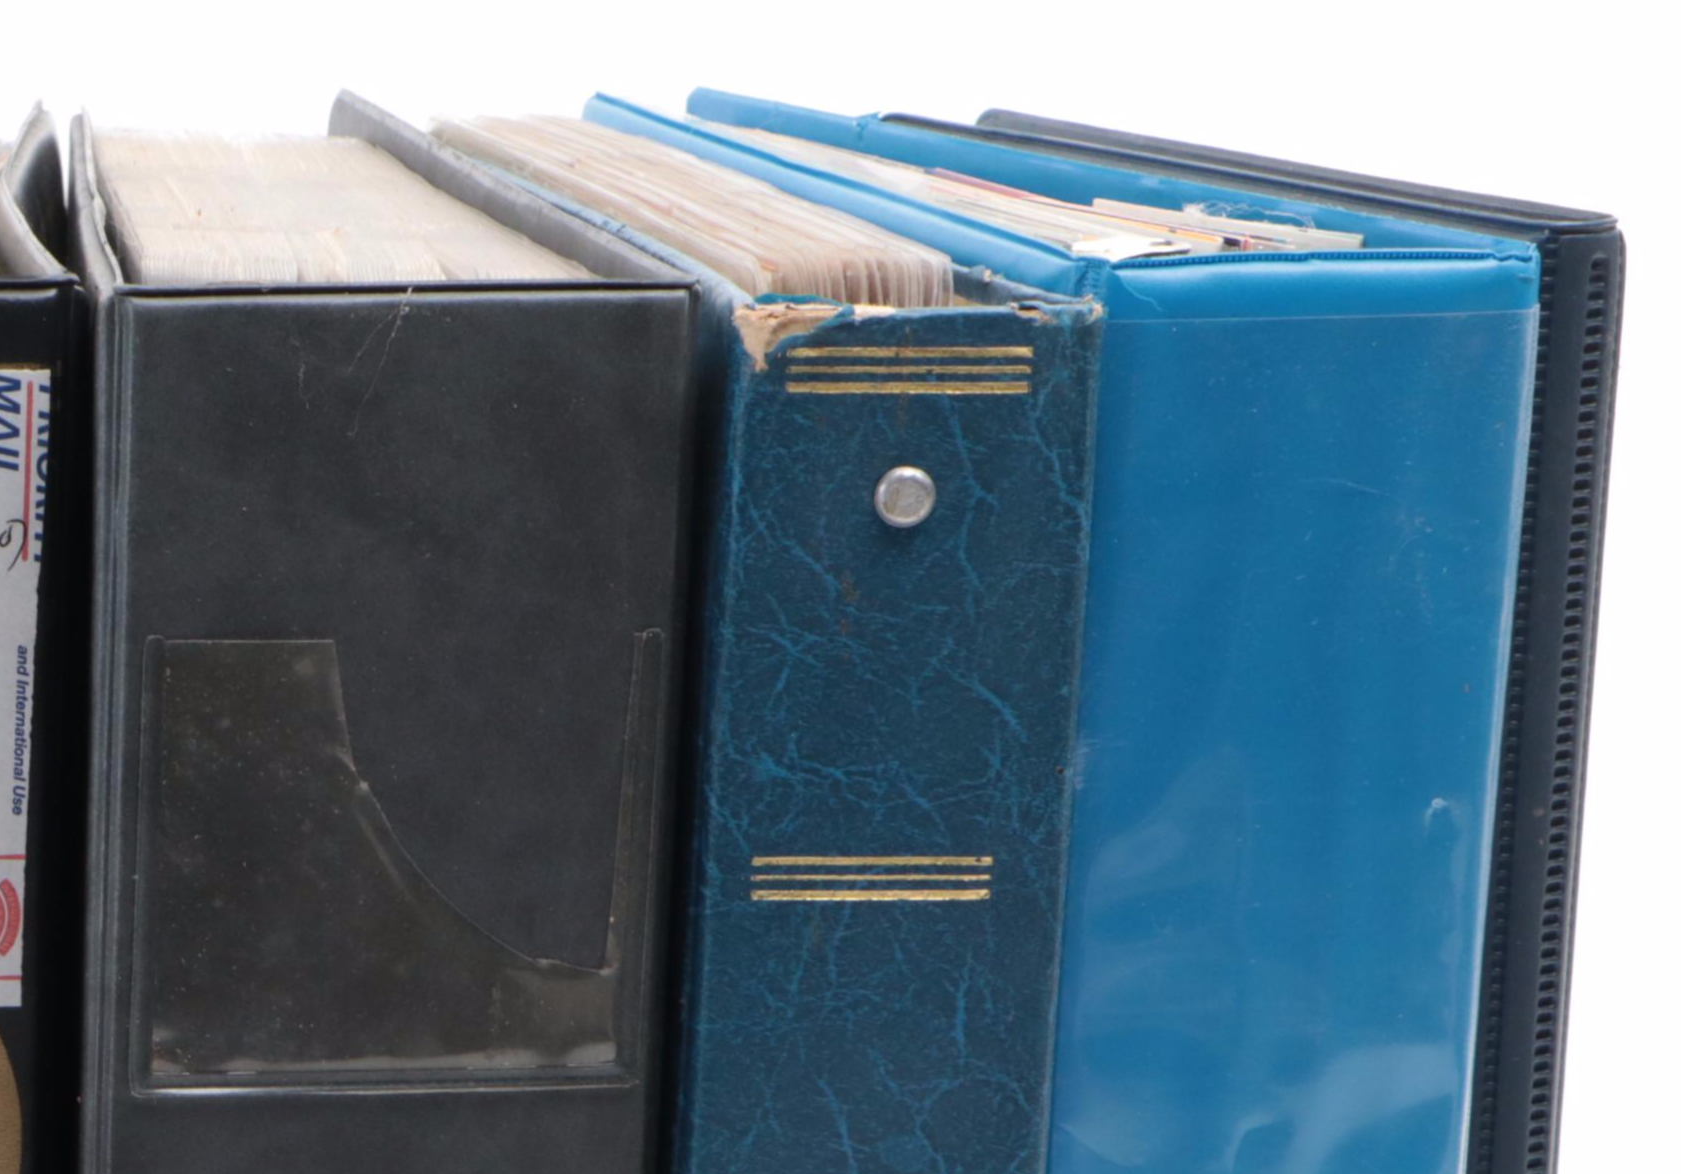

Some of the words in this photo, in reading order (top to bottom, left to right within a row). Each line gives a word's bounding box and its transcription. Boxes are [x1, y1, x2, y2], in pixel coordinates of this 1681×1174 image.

[16, 645, 29, 676] and
[13, 680, 28, 781] International
[11, 784, 26, 817] Use
